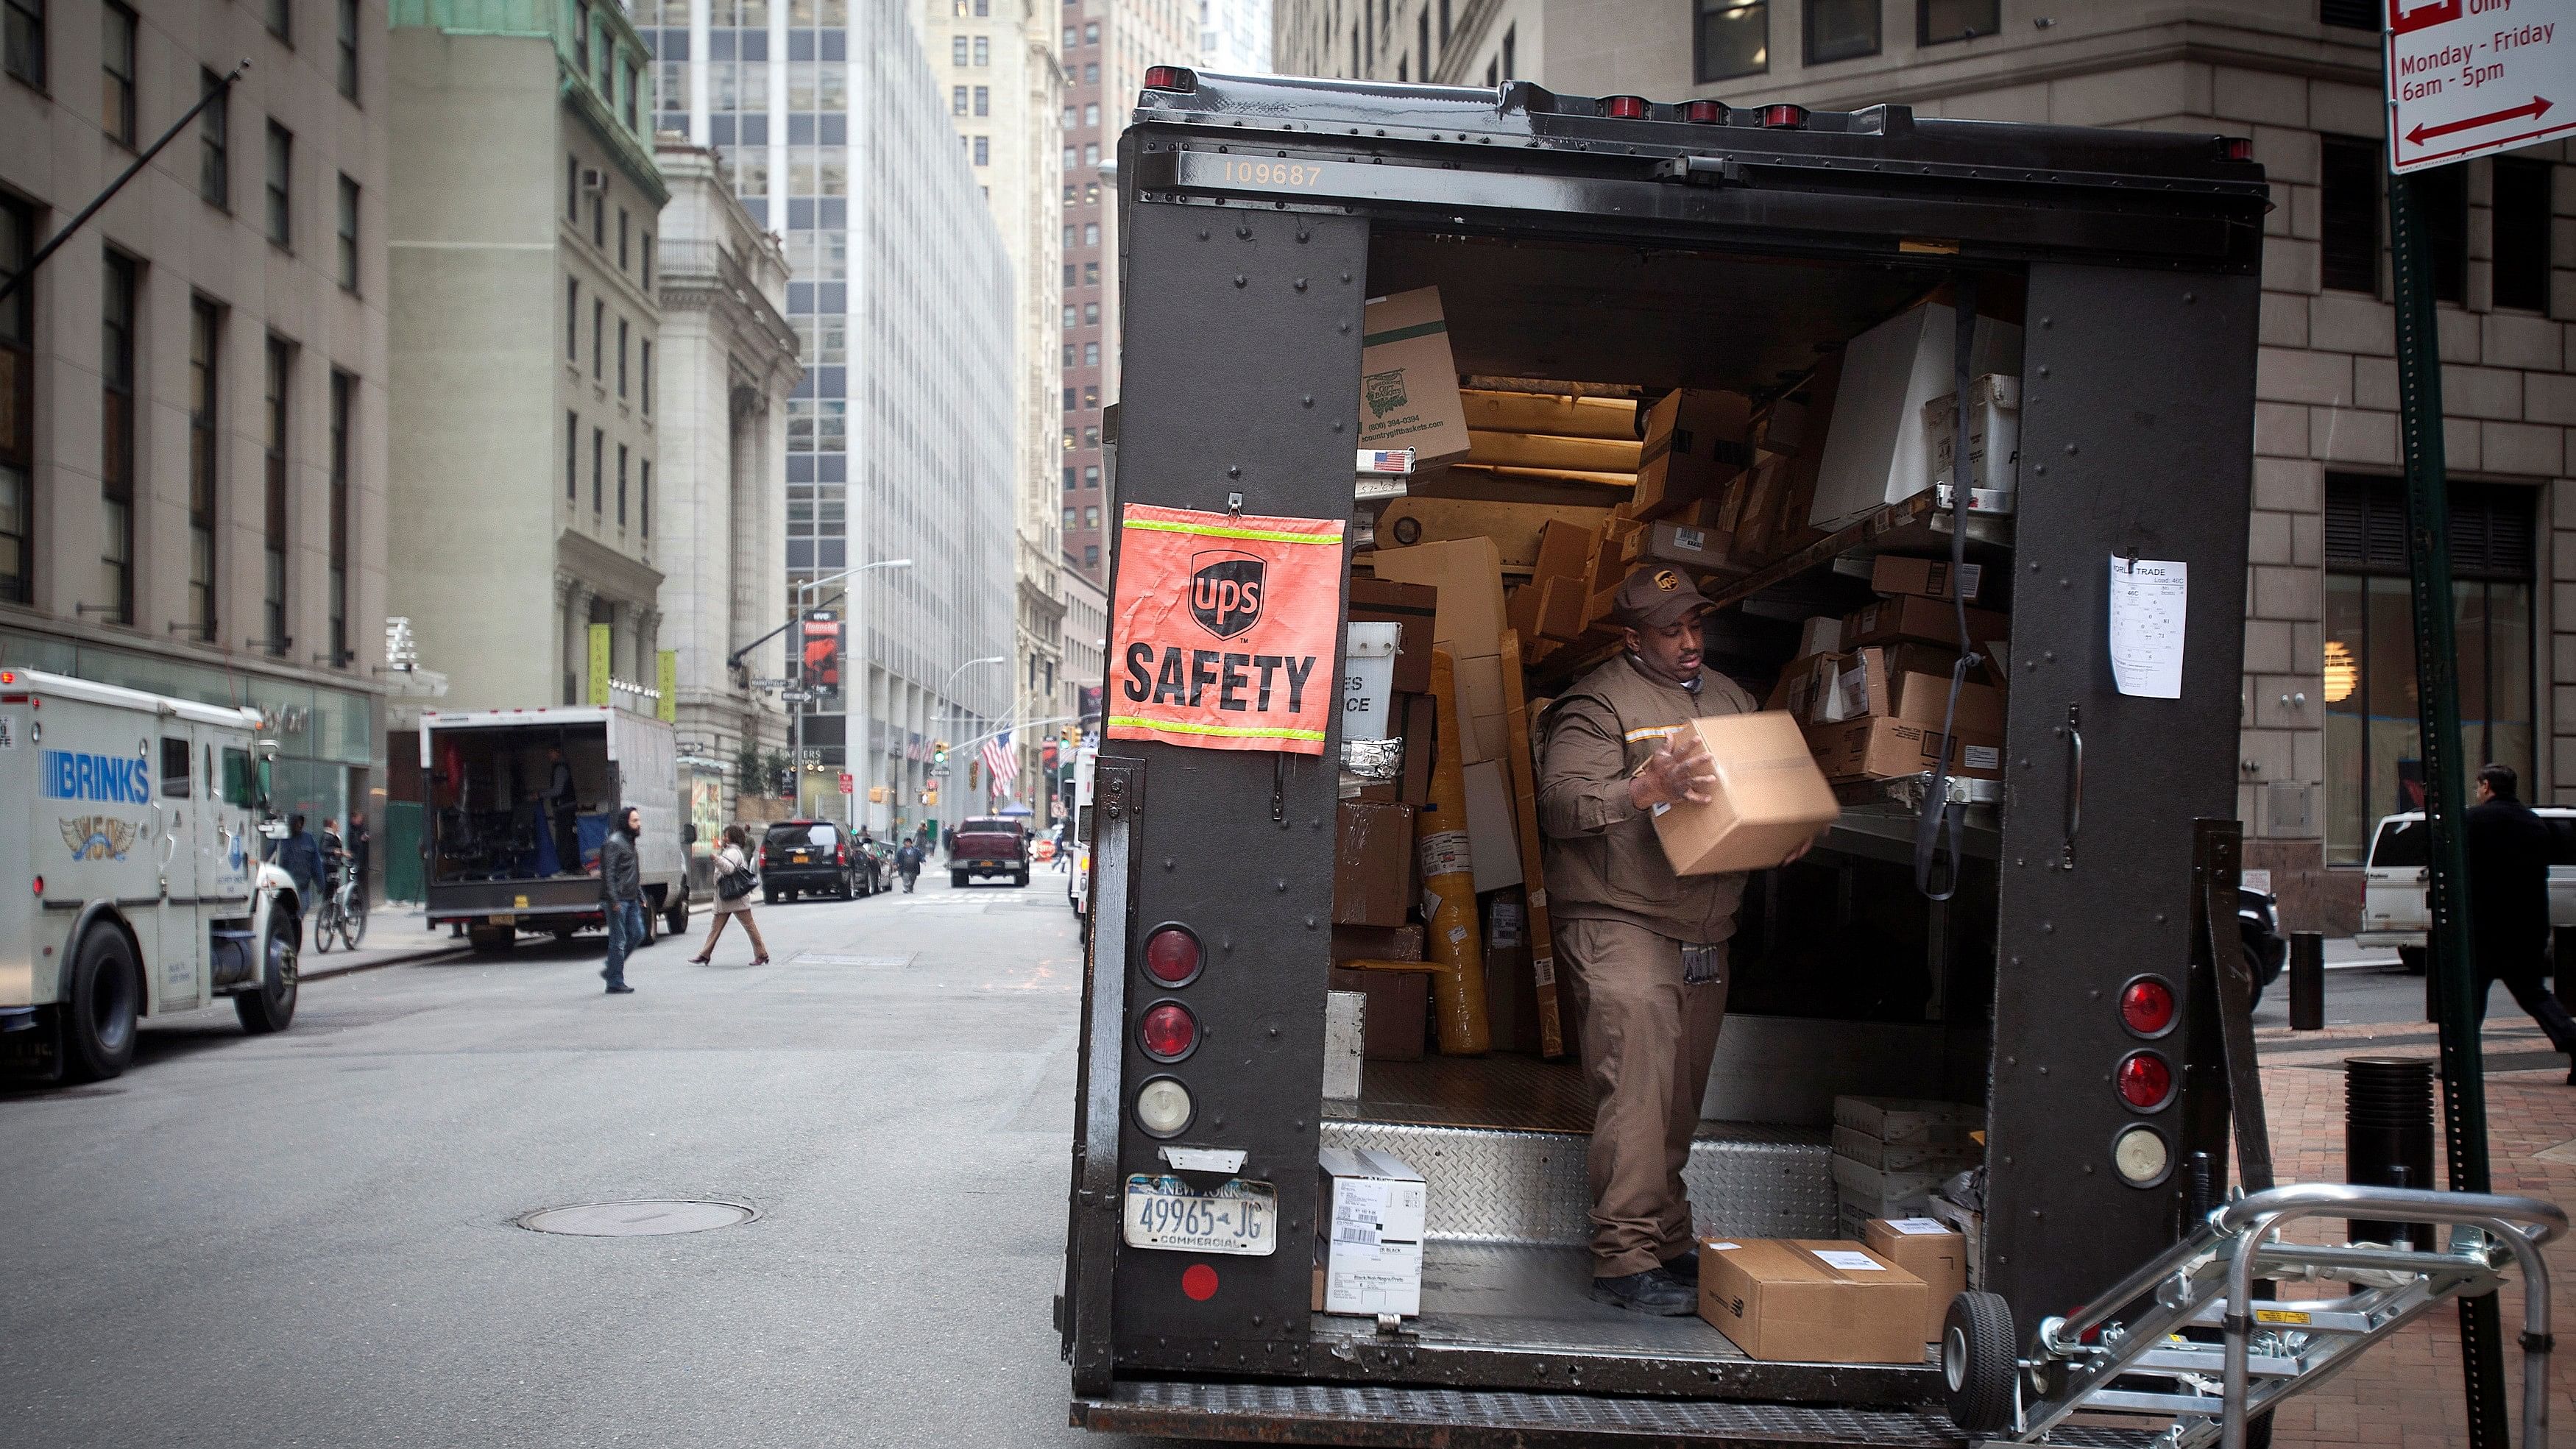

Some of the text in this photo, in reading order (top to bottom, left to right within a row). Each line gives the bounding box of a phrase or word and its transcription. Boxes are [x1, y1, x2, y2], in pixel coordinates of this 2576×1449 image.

[2402, 44, 2474, 77] Monday
[2494, 22, 2555, 52] Friday
[2403, 77, 2442, 102] 6am
[2463, 63, 2505, 88] 5pm
[1225, 160, 1322, 186] 109687
[1369, 421, 1386, 433] (800)
[1660, 575, 1677, 589] ups
[2113, 565, 2166, 576] ORL TRADE
[1195, 577, 1259, 625] ups
[1124, 642, 1316, 714] SAFETY
[57, 751, 149, 806] BRINKS
[1164, 1180, 1195, 1197] NEW
[1160, 1235, 1241, 1249] COMMERCIAL
